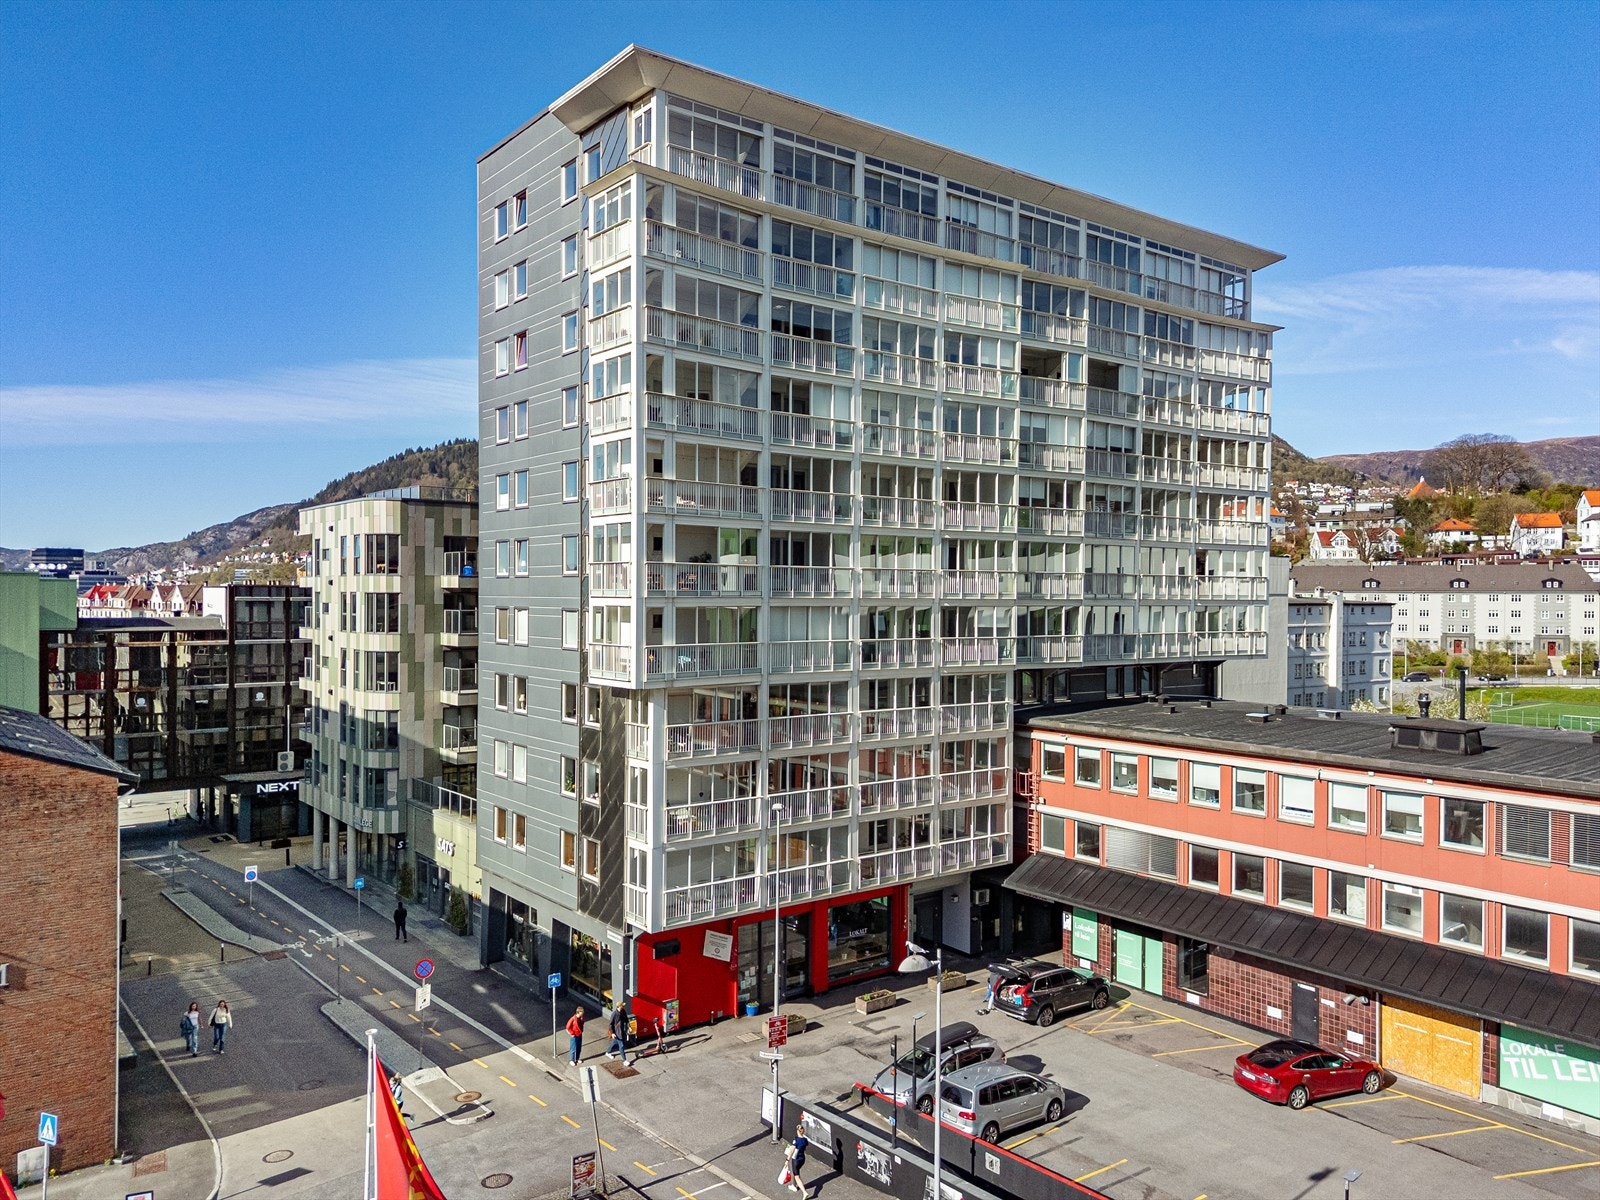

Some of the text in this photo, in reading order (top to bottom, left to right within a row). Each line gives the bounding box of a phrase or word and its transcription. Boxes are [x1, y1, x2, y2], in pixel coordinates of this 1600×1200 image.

[256, 781, 300, 794] NEXT
[437, 837, 455, 856] SATS
[1064, 913, 1071, 922] P
[1074, 922, 1095, 933] Lokaler
[1500, 1043, 1566, 1057] LOKALE
[1503, 1057, 1600, 1083] TIL LEI
